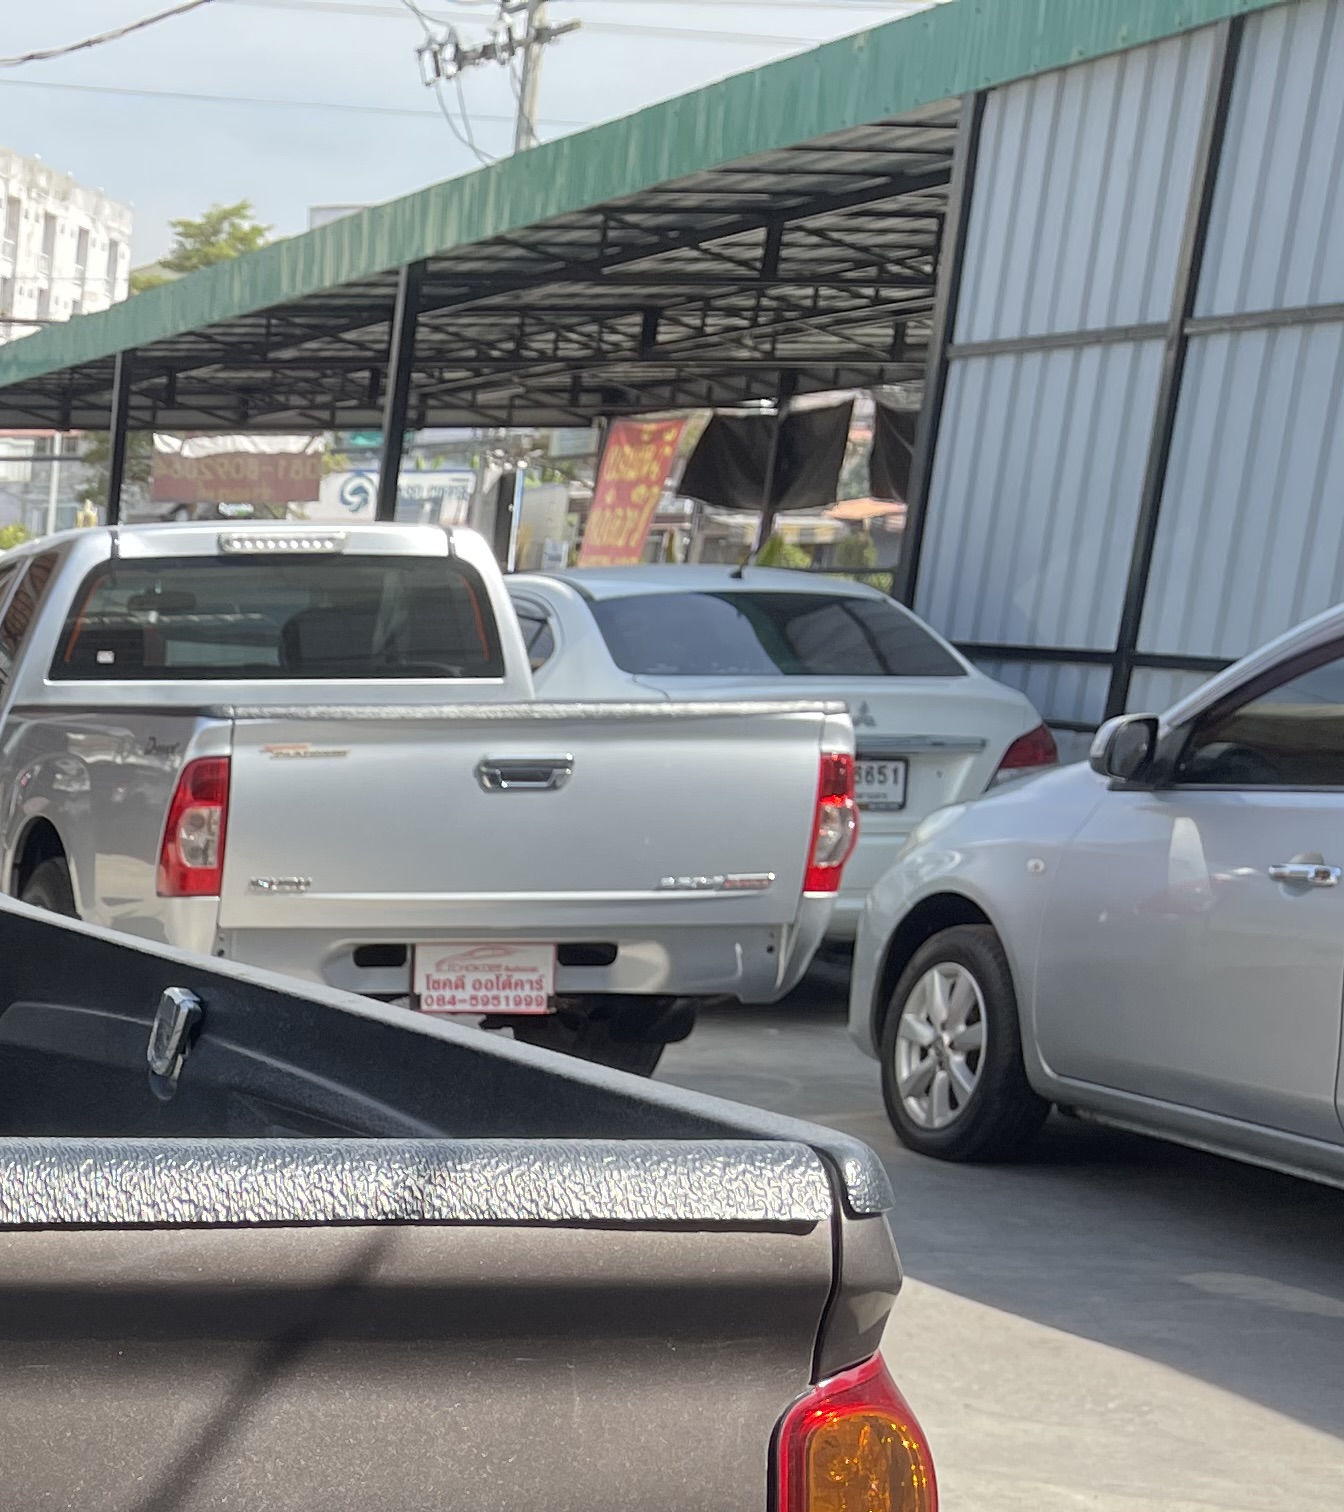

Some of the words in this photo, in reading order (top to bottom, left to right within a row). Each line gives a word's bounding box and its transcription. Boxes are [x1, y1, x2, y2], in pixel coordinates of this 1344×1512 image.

[425, 974, 466, 992] โชคดี
[472, 974, 545, 992] ออโต้คาร์
[424, 994, 545, 1008] 084-5951999
